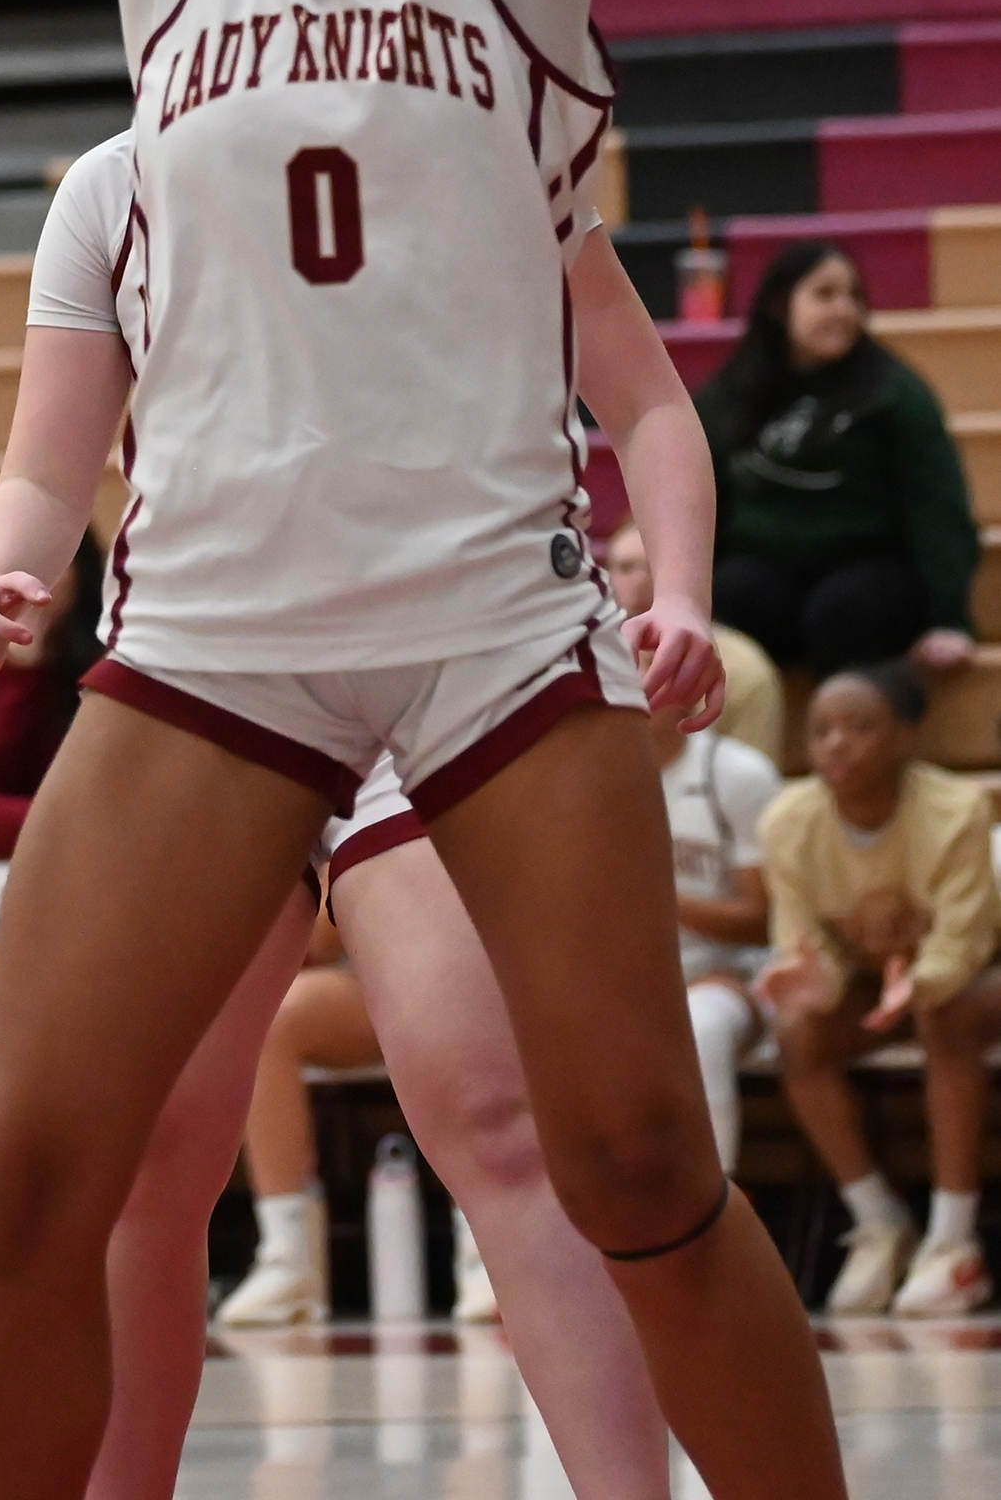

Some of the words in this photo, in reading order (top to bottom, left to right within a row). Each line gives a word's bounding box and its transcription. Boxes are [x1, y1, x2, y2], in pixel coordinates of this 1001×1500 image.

[159, 12, 281, 134] LADY
[286, 2, 496, 112] KNIGHTS
[286, 146, 365, 286] 0
